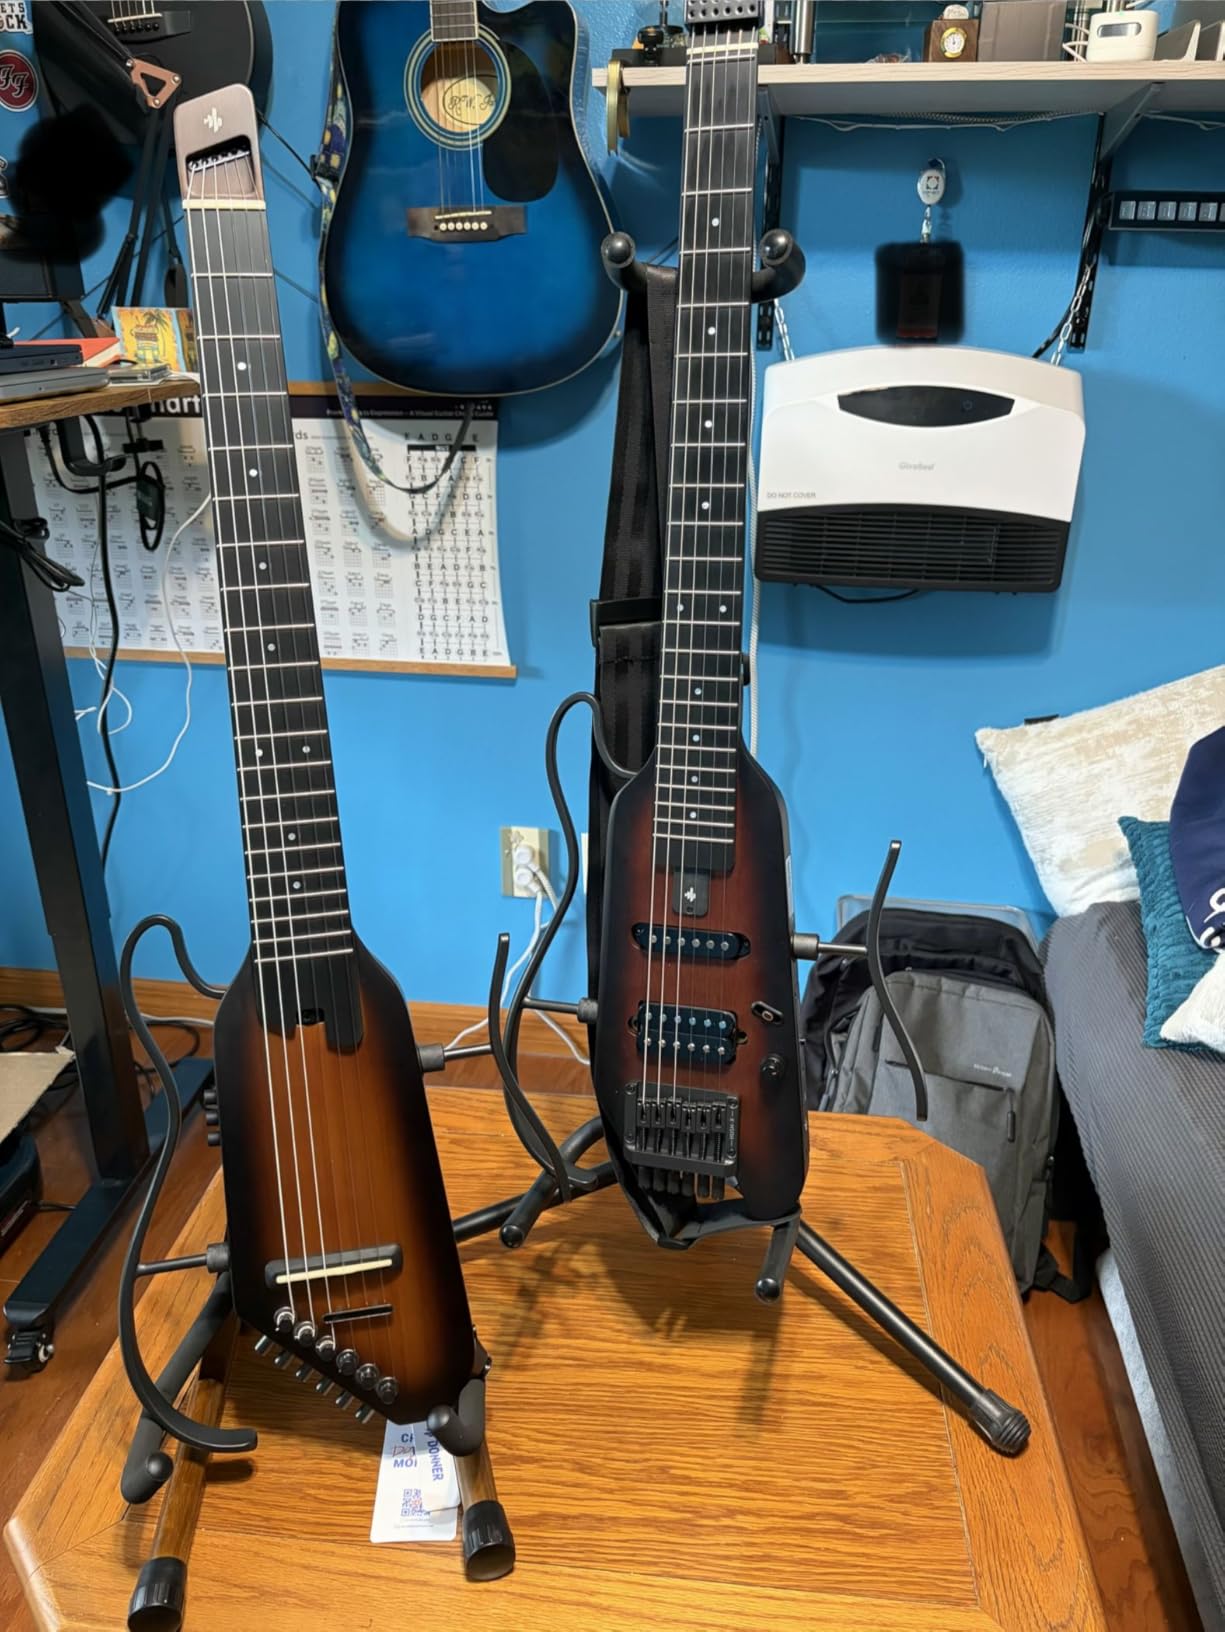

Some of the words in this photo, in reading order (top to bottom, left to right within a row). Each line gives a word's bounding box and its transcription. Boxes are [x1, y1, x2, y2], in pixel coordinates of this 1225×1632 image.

[767, 491, 777, 499] DO
[778, 491, 792, 499] NOT
[793, 491, 816, 499] COVER
[427, 1440, 444, 1481] DONNER
